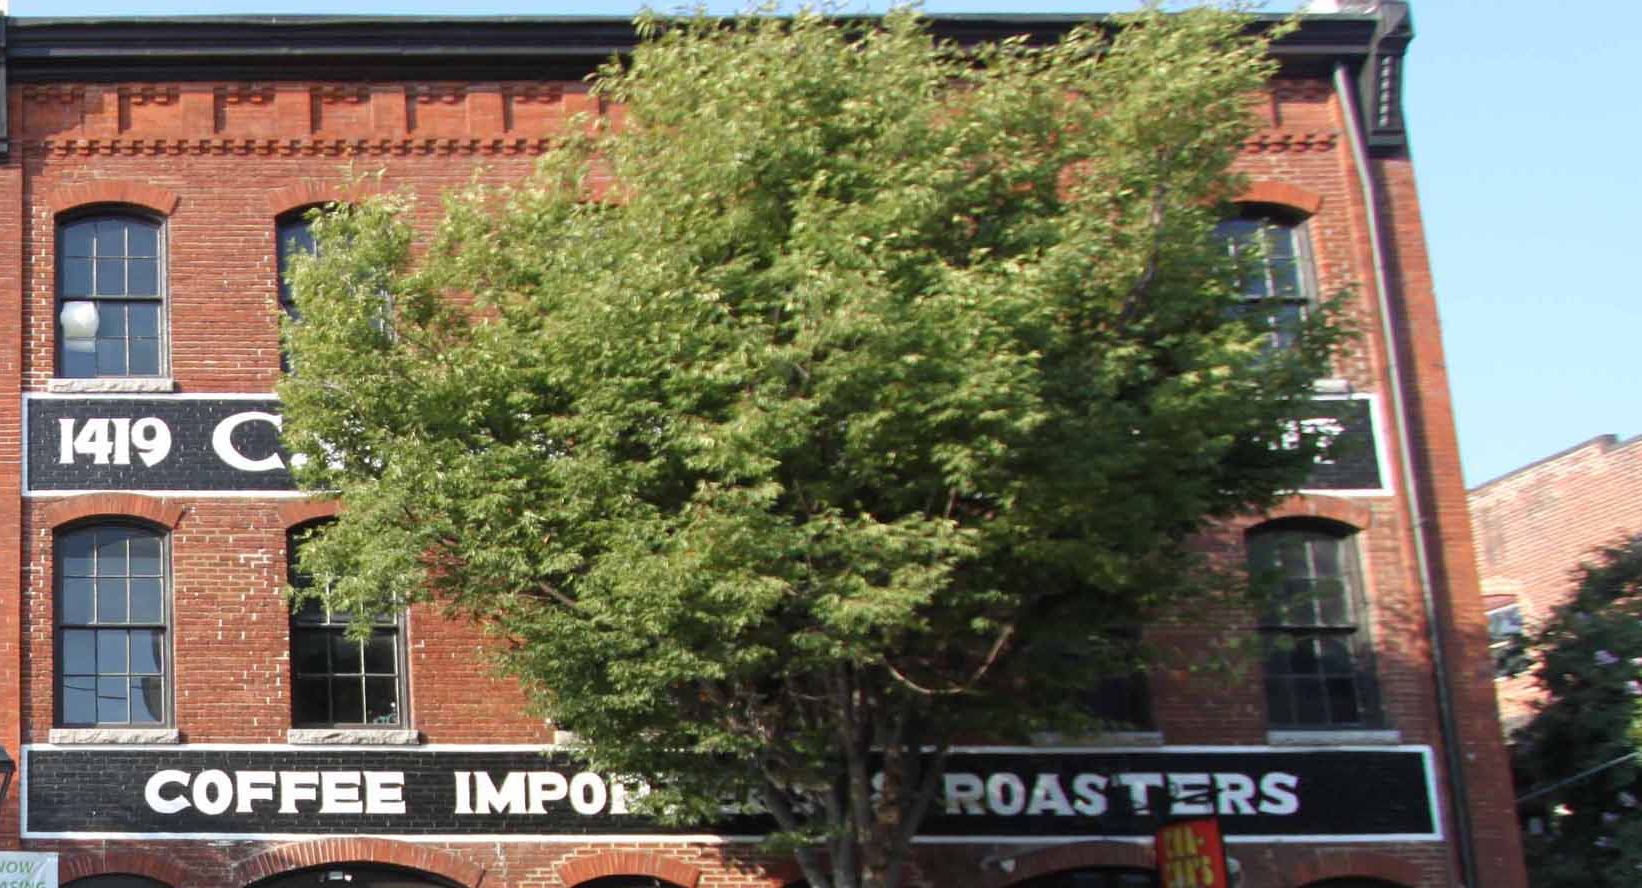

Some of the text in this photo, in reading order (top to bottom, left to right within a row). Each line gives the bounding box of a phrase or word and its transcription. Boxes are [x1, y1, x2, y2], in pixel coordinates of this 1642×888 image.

[58, 416, 173, 468] 1419
[144, 767, 407, 817] COFFEE
[944, 772, 1300, 816] ROASTERS
